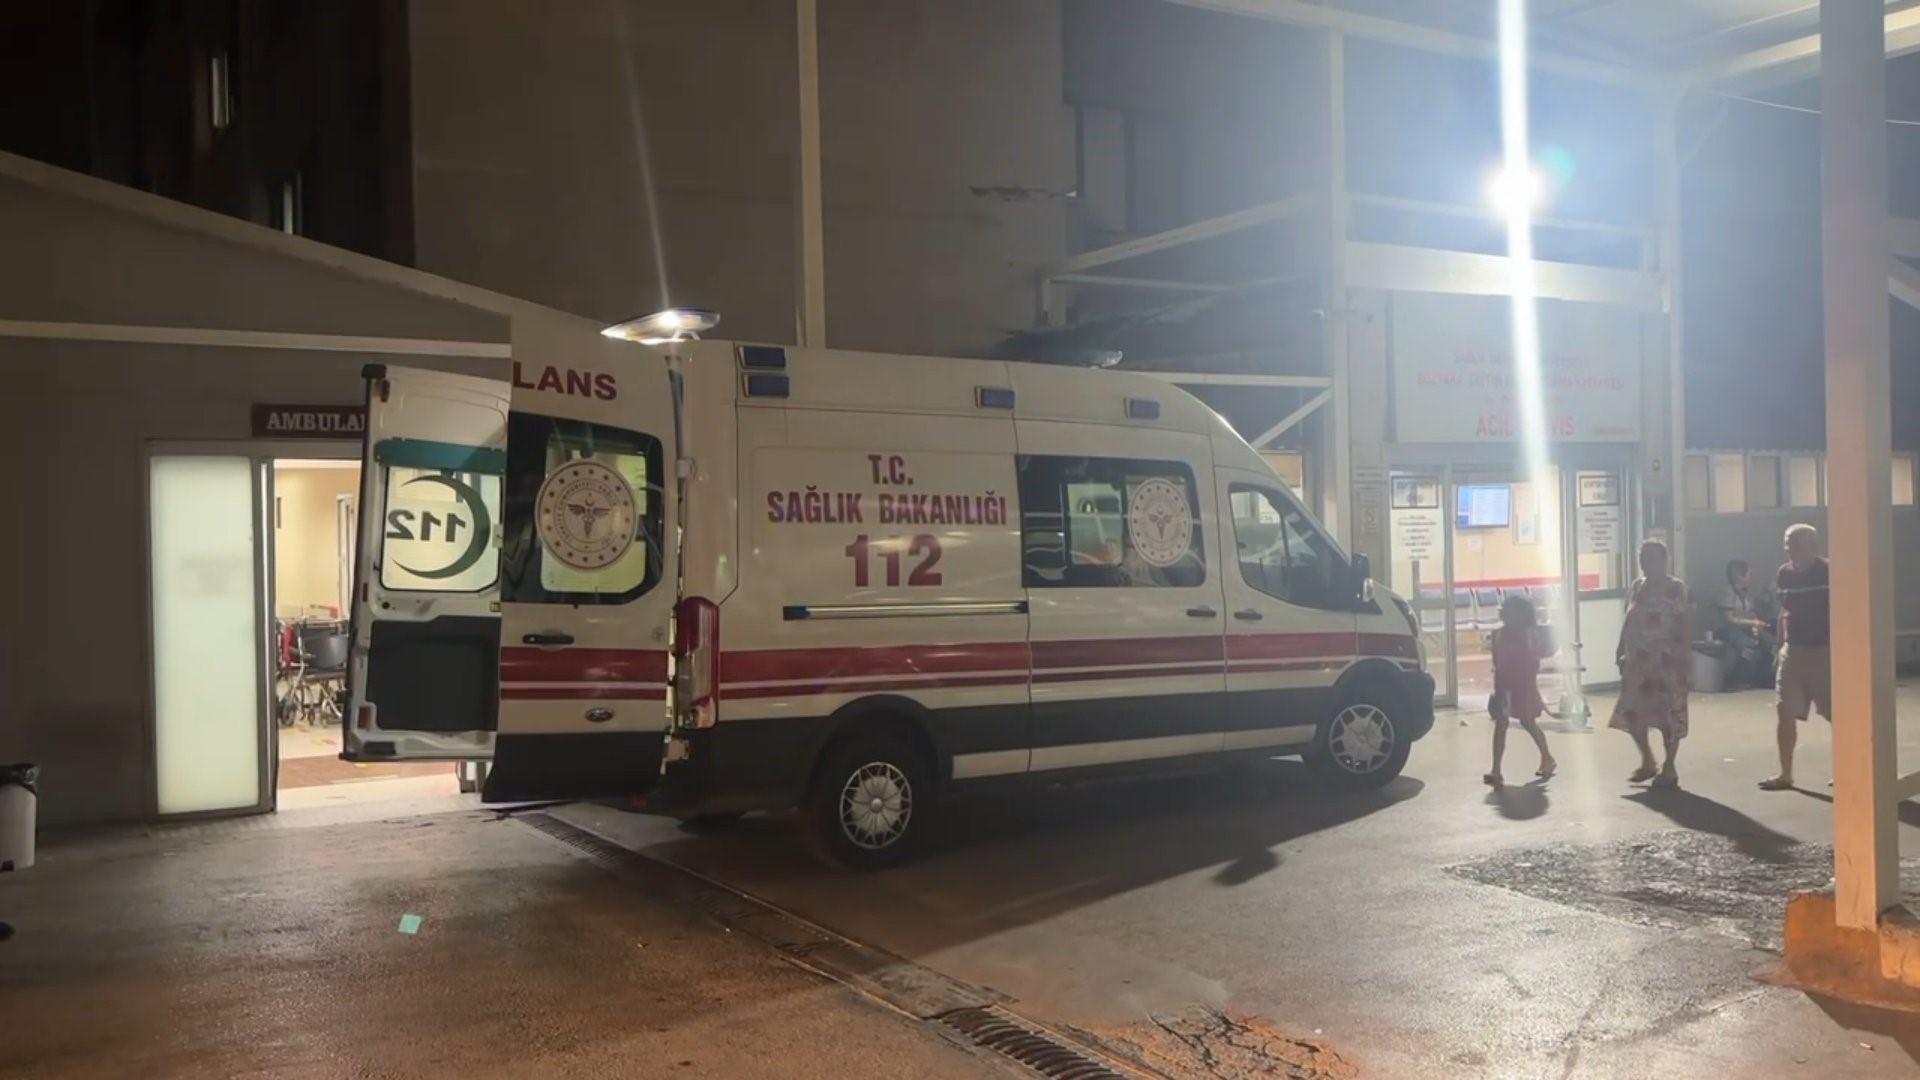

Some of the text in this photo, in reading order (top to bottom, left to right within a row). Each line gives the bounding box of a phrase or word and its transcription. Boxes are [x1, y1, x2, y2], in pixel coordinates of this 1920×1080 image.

[513, 361, 617, 400] LANS
[868, 454, 914, 485] T.C.
[767, 485, 1007, 525] SAĞLIK BAKANLIĞI
[845, 534, 943, 587] 112
